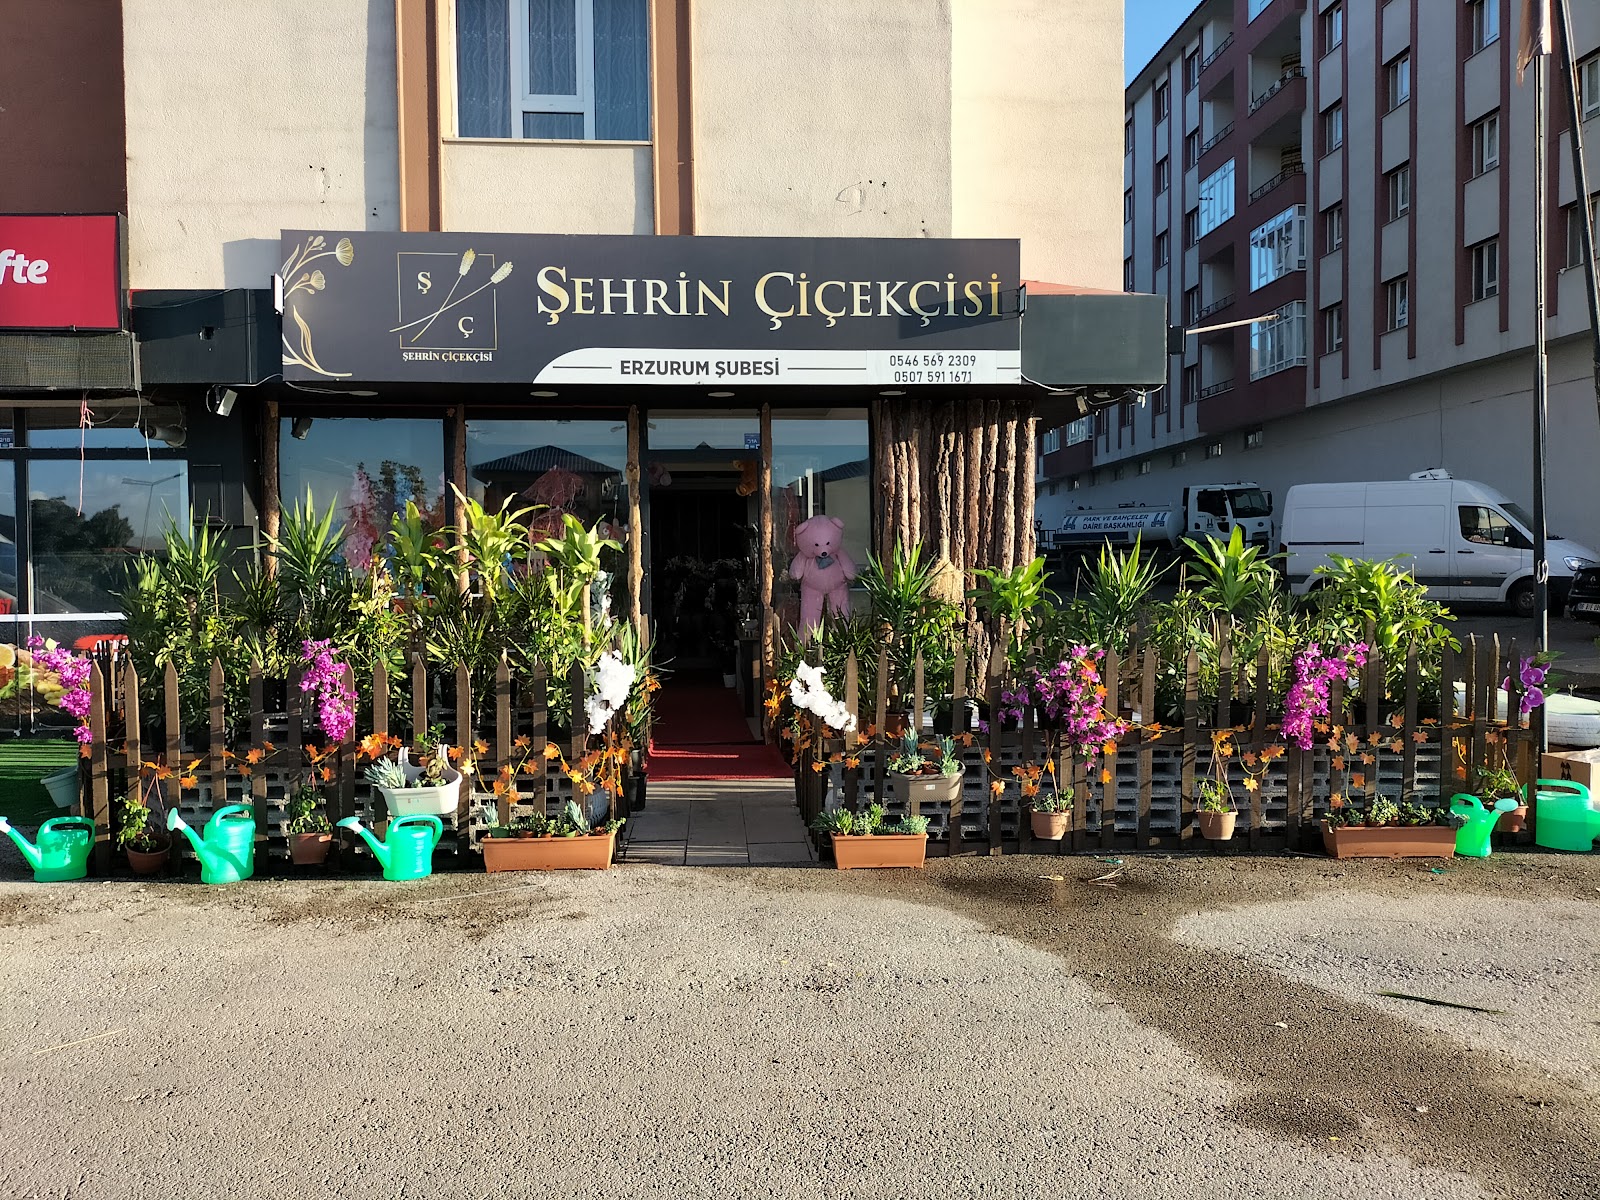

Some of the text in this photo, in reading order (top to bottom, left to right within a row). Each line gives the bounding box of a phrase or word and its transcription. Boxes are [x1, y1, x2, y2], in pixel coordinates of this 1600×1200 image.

[417, 271, 432, 294] Ş
[536, 266, 1002, 331] ŞEHRİN ÇİÇEKÇİSİ
[458, 316, 474, 338] Ç
[402, 351, 493, 363] ŞEHRİN ÇİÇEKÇİSİ
[889, 355, 977, 367] 0546 569 2309
[620, 358, 780, 378] ERZURUM ŞUBESİ
[894, 371, 972, 383] 0507 591 1671
[1082, 520, 1145, 530] DAİRE BAŞKANLIĞI
